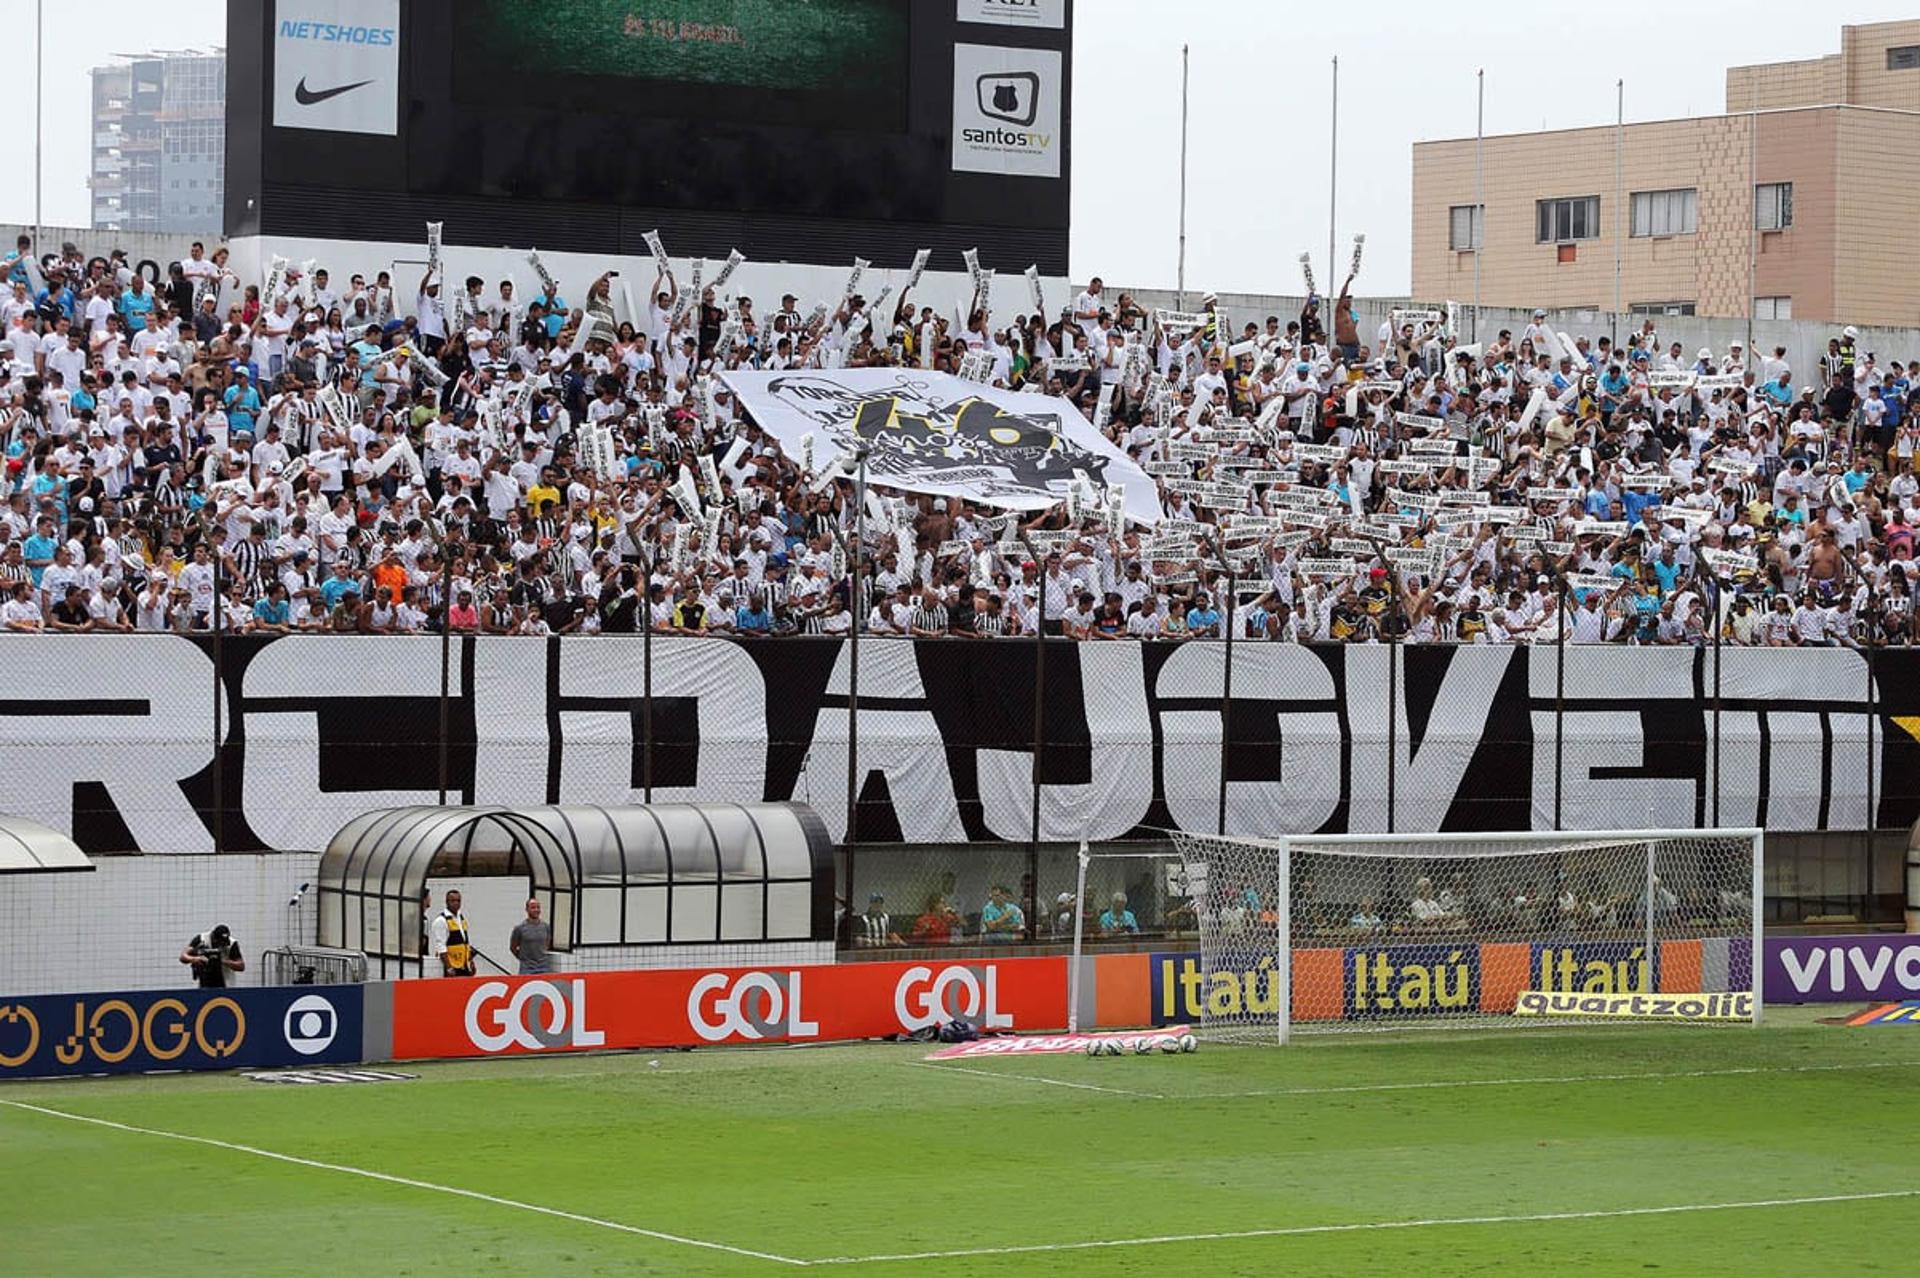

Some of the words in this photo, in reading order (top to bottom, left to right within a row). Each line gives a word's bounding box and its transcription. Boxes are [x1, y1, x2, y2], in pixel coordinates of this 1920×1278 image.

[281, 21, 394, 46] NETSHOES
[895, 964, 1013, 1032] GOL
[1163, 956, 1281, 1017] Itaú
[1355, 951, 1469, 1010] Itaú
[1542, 946, 1648, 994] Itaú
[55, 996, 246, 1064] JOGO
[464, 978, 606, 1052] GOL
[687, 971, 819, 1042] GOL
[1520, 991, 1754, 1018] quartzolit
